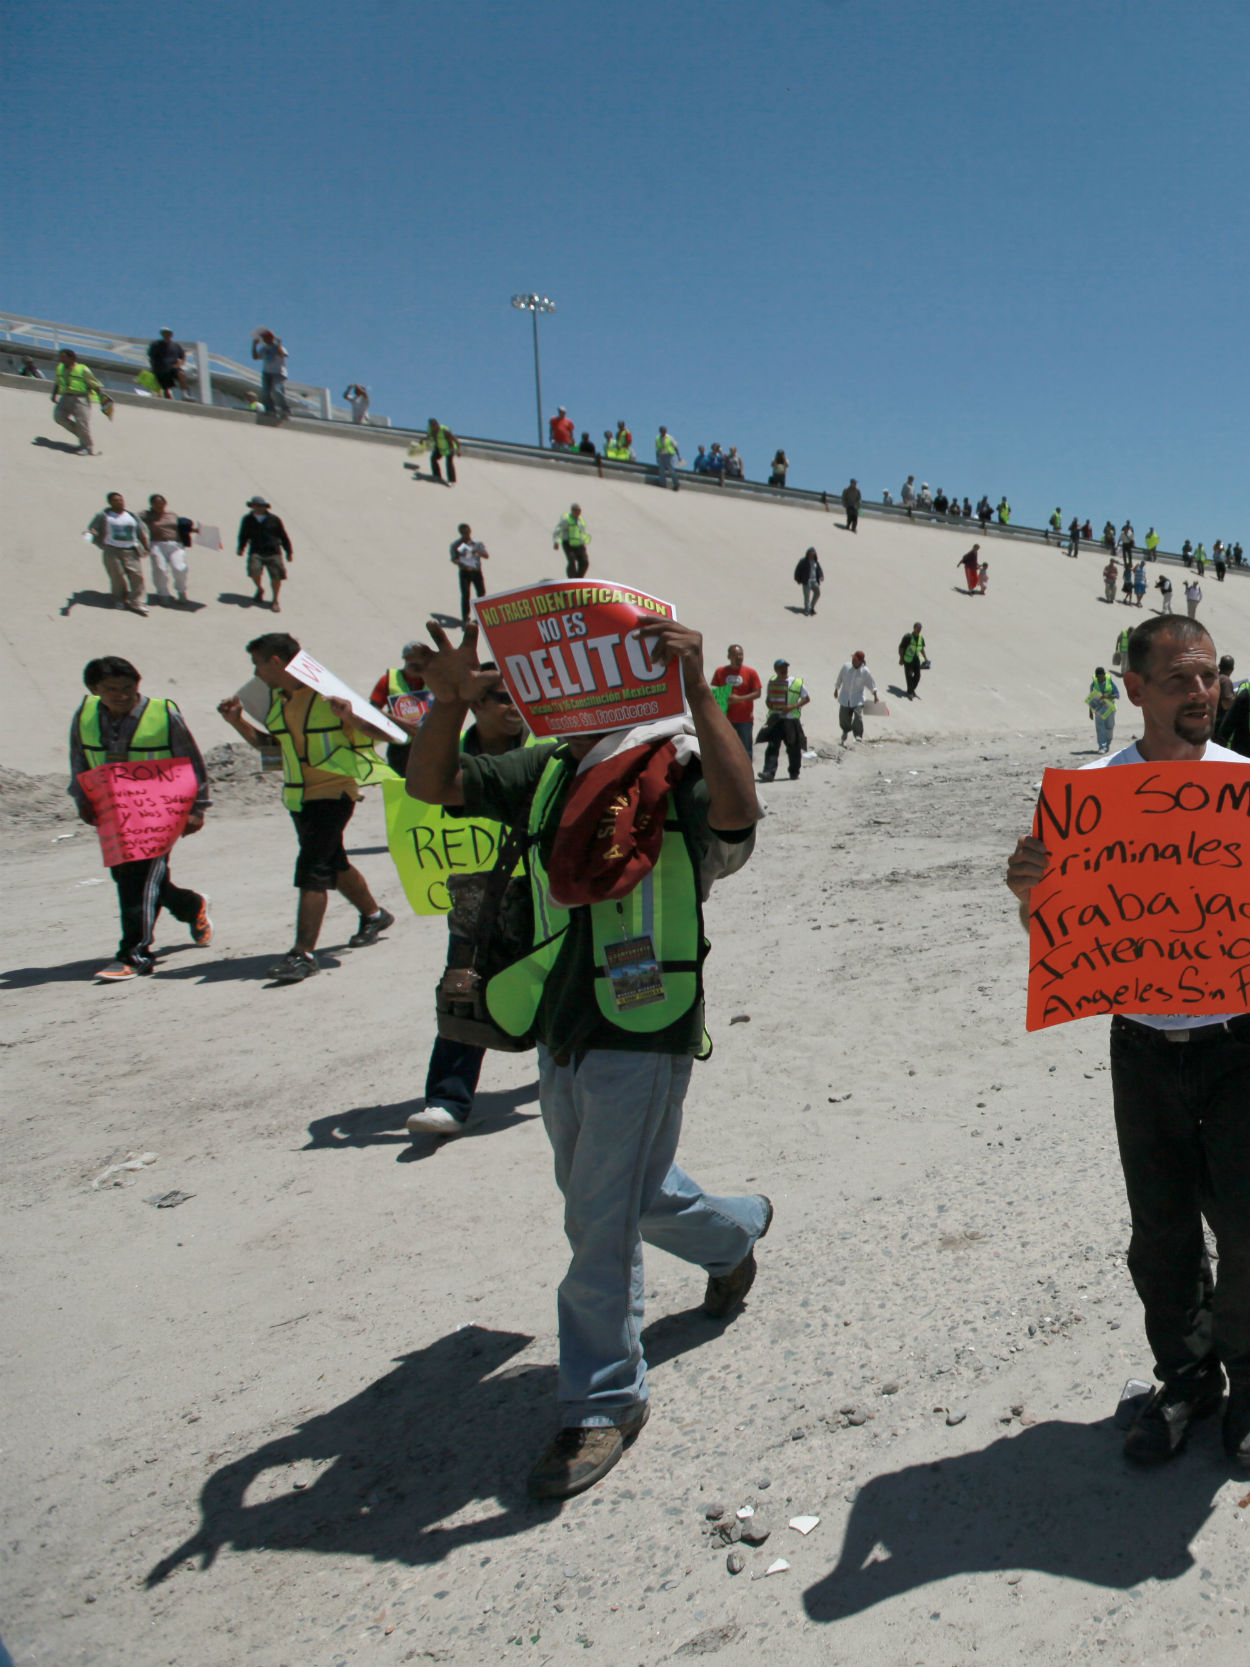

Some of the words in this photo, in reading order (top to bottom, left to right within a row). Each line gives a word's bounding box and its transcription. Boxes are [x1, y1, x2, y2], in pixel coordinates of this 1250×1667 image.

[482, 606, 500, 628] NO
[499, 599, 534, 626] TRAER
[532, 587, 667, 616] IDENTIFICACIÓN
[537, 617, 562, 644] NO
[562, 611, 587, 638] ES
[505, 628, 667, 703] DELITO
[622, 683, 668, 701] Mexicana
[596, 701, 659, 724] Fronteras
[1043, 977, 1174, 1023] Angeles
[1178, 965, 1225, 1004] Sin
